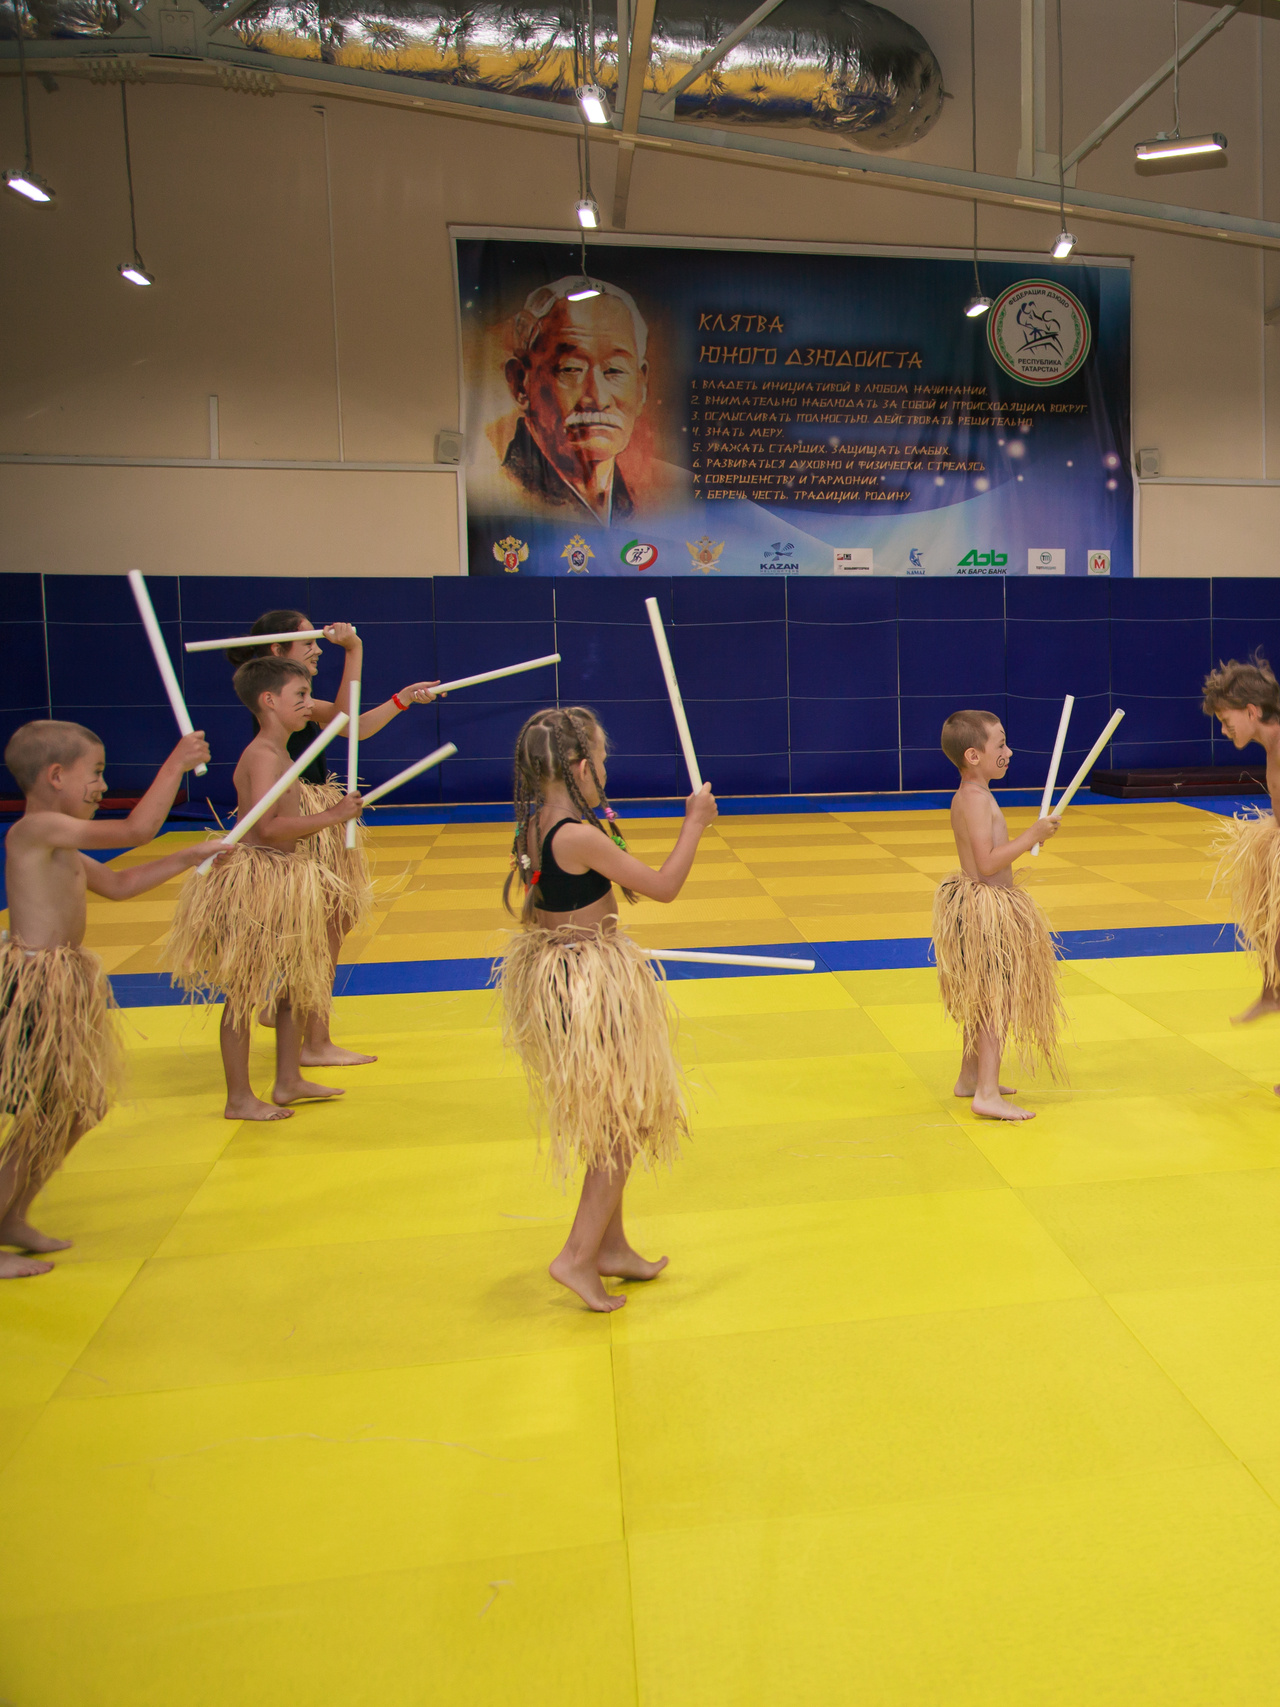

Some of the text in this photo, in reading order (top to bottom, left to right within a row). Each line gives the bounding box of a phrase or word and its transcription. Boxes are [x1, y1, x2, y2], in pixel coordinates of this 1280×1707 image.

[1008, 289, 1069, 308] ФЕДЕРАЦИЯ ДЗЮДО
[698, 313, 784, 333] КЛЯТВА
[699, 346, 923, 368] ЮНОГО ДЗЮДОИСТА
[1018, 358, 1061, 366] РЕСПУБЛИКА
[1021, 365, 1058, 373] ТАТАРСТАН
[702, 380, 758, 390] ВЛАДЕТЬ
[762, 381, 851, 394] ИНИЦИАТИВОЙ
[854, 383, 861, 393] В
[864, 384, 909, 394] ЛЮБОМ
[704, 395, 798, 406] ВНИМАТЕЛЬНО
[802, 397, 878, 408] НАБЛЮДАТЬ
[883, 400, 898, 410] ЗА
[901, 399, 936, 410] СОБОЙ
[939, 401, 948, 410] И
[952, 401, 1046, 414] ПРОИСХОДЯЩИМ
[704, 411, 792, 422] ОСМЫСЛИВАТЬ
[873, 413, 953, 425] ДЕЙСТВОВАТЬ
[705, 427, 745, 437] ЗНАТЬ
[749, 428, 785, 438] МЕРУ.
[706, 443, 765, 453] УВАЖАТЬ
[831, 444, 900, 458] ЗАЩИЩАТЬ
[706, 458, 786, 469] РАЗВИВАТЬСЯ
[789, 460, 842, 469] ДУХОВНО
[845, 460, 854, 470] И
[927, 461, 986, 471] СТРЕМЯСЬ
[692, 474, 879, 486] К СОВЕРШЕНСТВУ И ГАРМОНИИ.
[707, 490, 748, 500] БЕРЕЧЬ
[865, 491, 912, 501] РОДИНУ.
